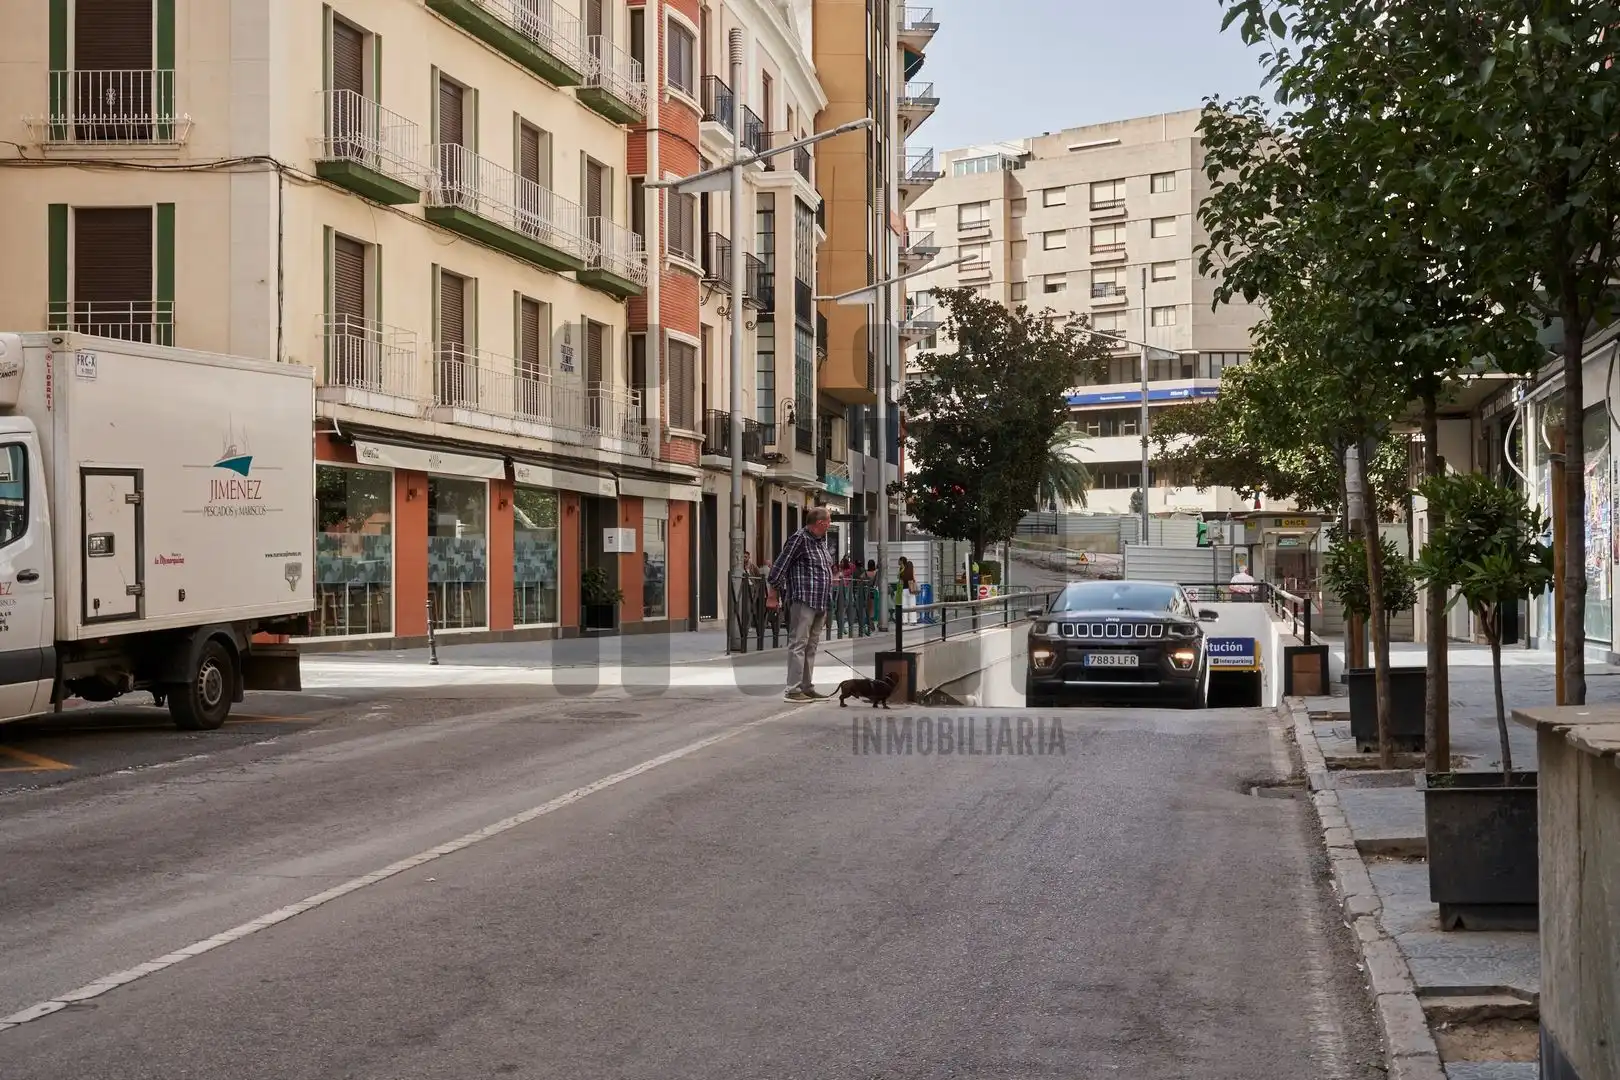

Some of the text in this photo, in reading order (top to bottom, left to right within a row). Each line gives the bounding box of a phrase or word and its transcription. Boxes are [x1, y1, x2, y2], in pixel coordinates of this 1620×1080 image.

[209, 473, 262, 503] JIMÉNEZ
[203, 506, 233, 517] PESCADOS
[239, 505, 267, 516] MARISCOS
[1090, 655, 1136, 665] 7883 LFR
